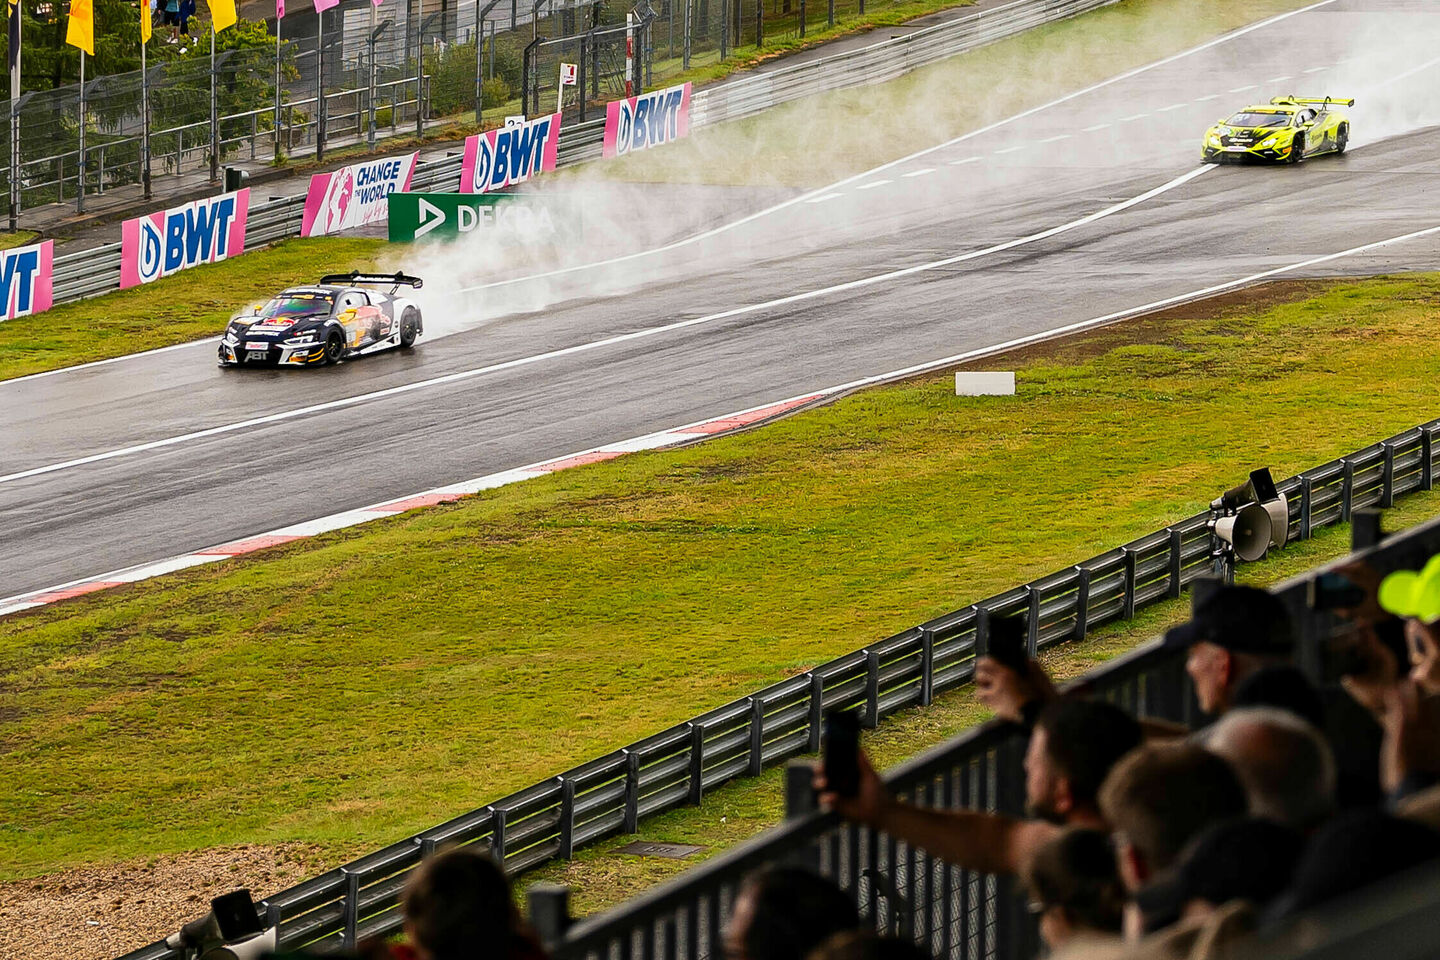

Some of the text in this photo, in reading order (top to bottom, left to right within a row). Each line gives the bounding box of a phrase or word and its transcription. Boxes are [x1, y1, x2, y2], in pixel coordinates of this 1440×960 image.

[632, 89, 683, 149] BWT
[491, 120, 550, 184] BWT
[357, 161, 401, 186] CHANGE
[361, 182, 396, 205] WORLD
[165, 198, 235, 272] BWT
[244, 351, 270, 362] ABT
